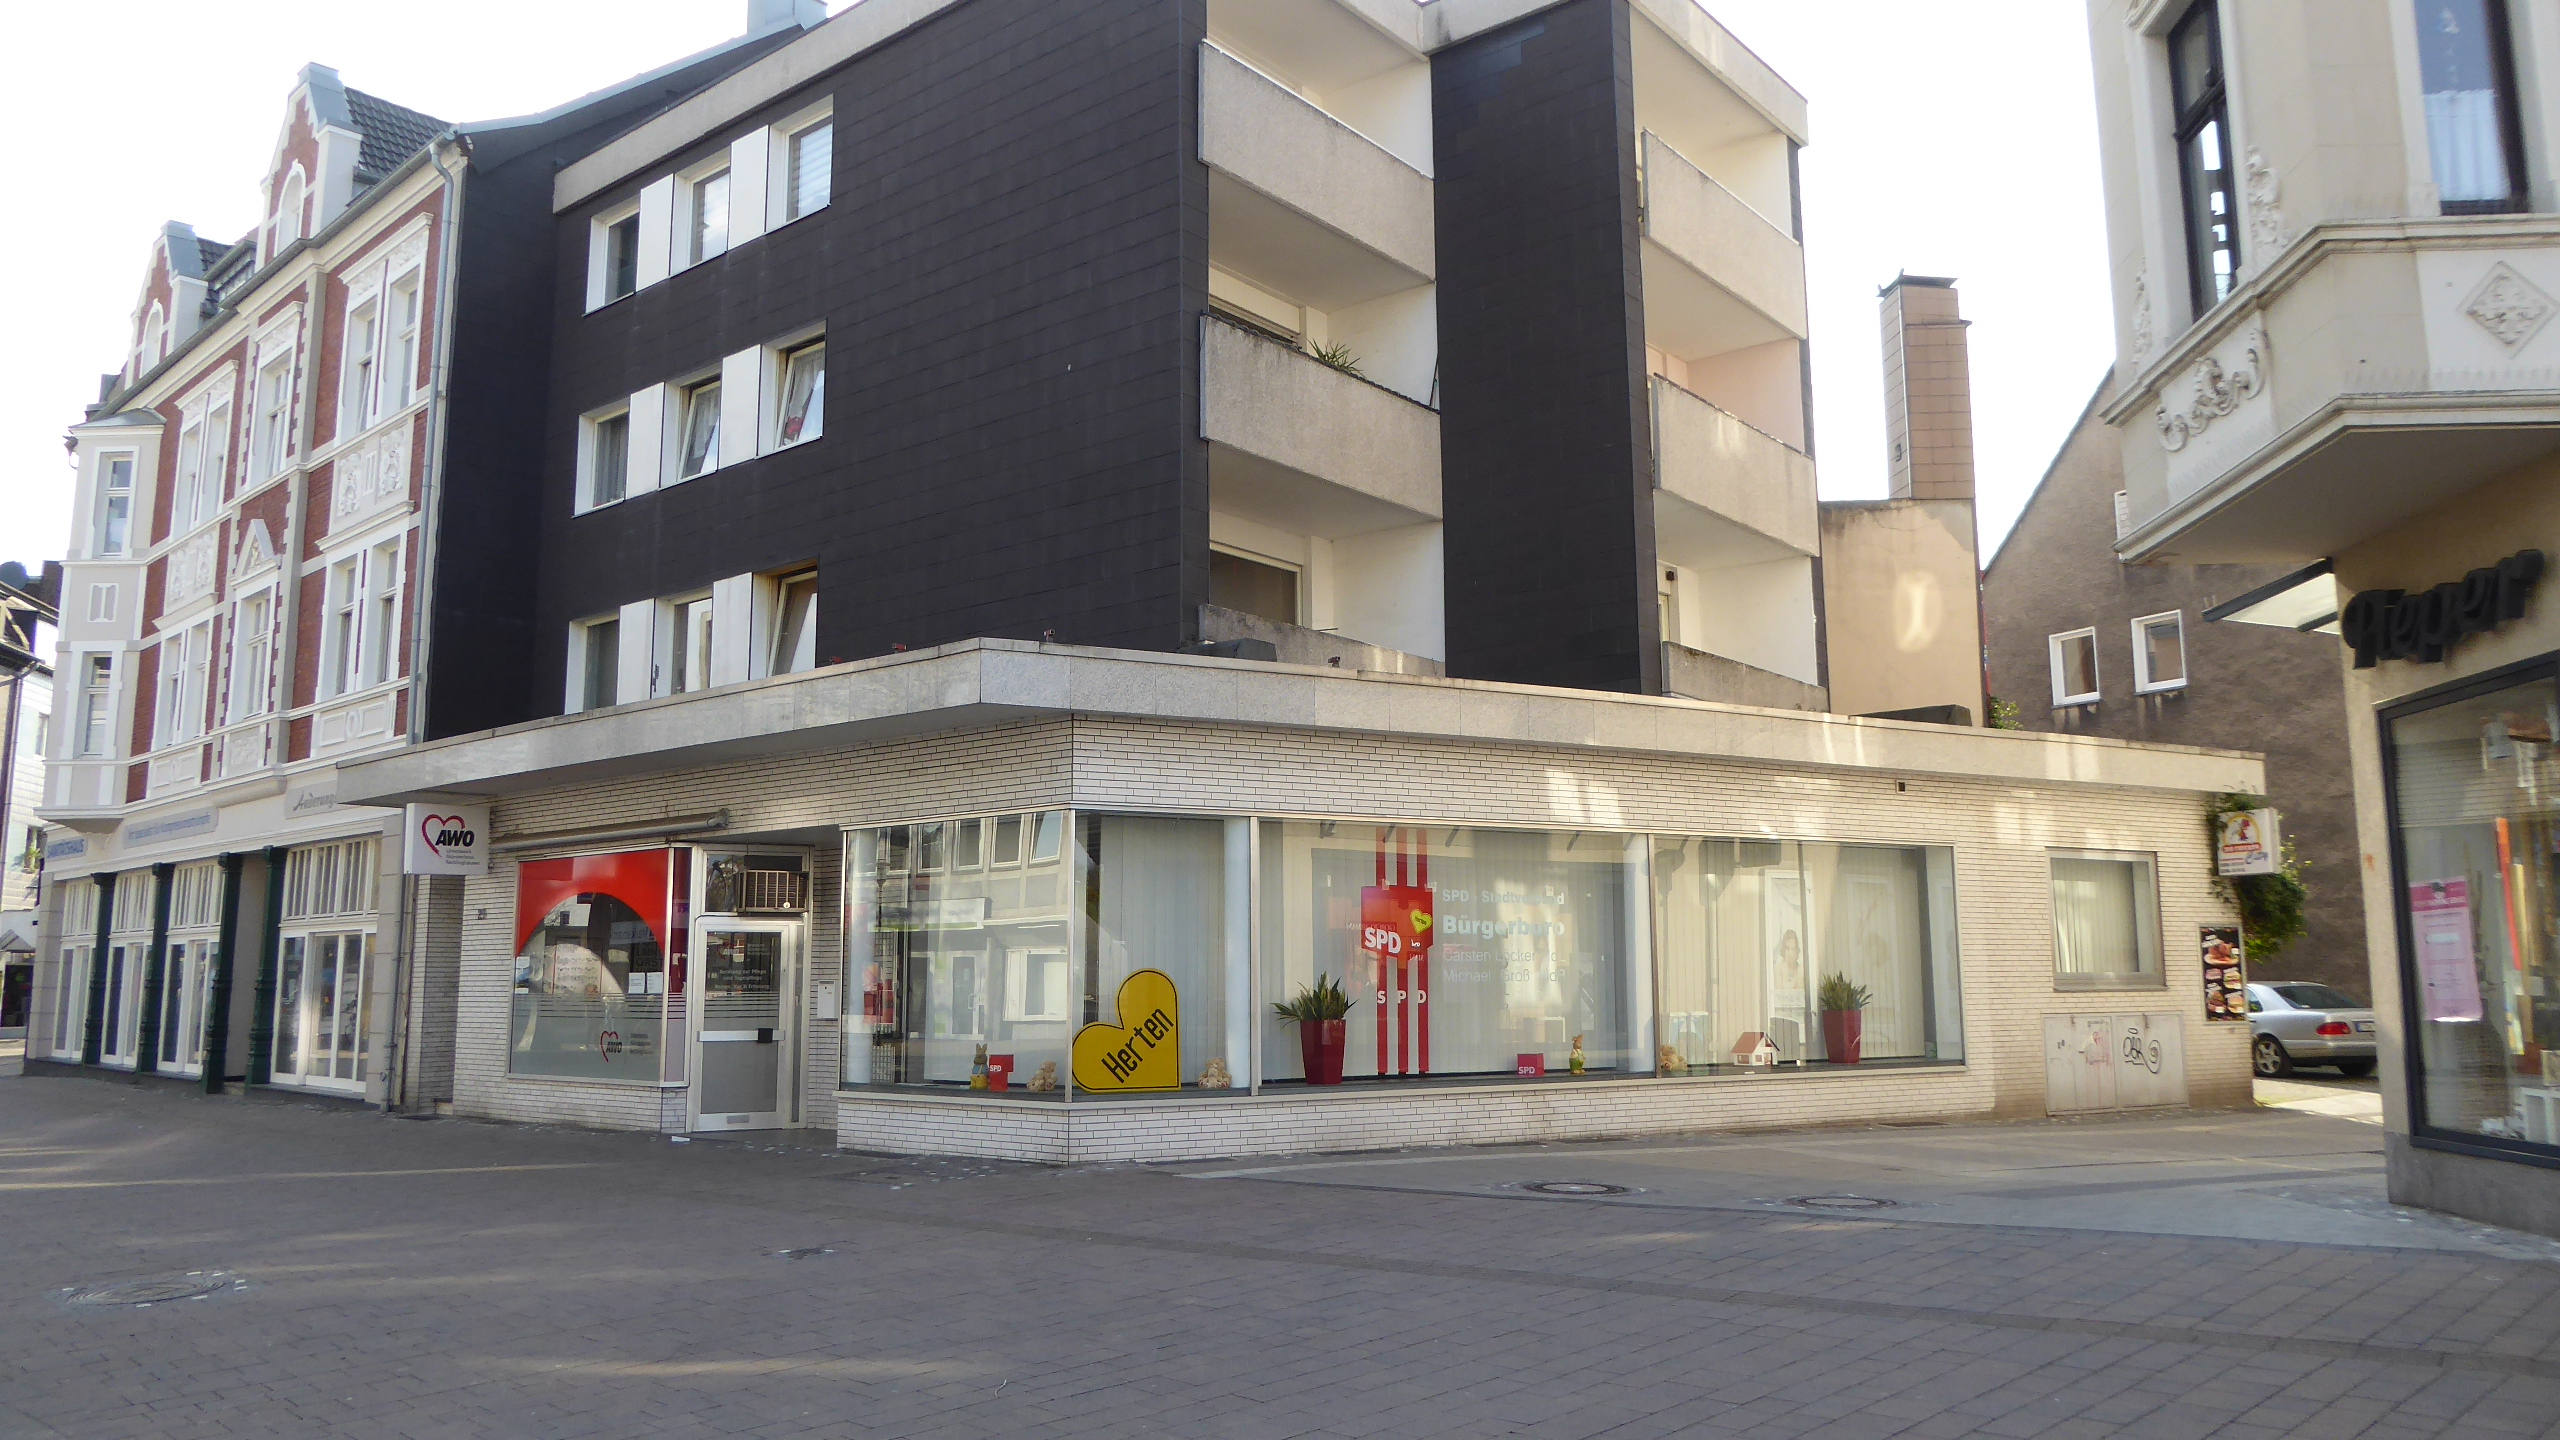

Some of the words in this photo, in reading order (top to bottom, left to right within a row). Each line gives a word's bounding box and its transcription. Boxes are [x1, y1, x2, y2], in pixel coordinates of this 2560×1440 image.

[435, 829, 475, 847] AWO
[1442, 889, 1470, 902] SPD
[1364, 926, 1402, 954] SPD
[1443, 947, 1491, 962] Carsten
[1443, 968, 1491, 982] Michael
[1502, 968, 1530, 982] Groß
[606, 1041, 623, 1054] AWO
[1101, 1008, 1174, 1084] Herten
[989, 1064, 1002, 1072] SPD
[1518, 1066, 1536, 1074] SPD
